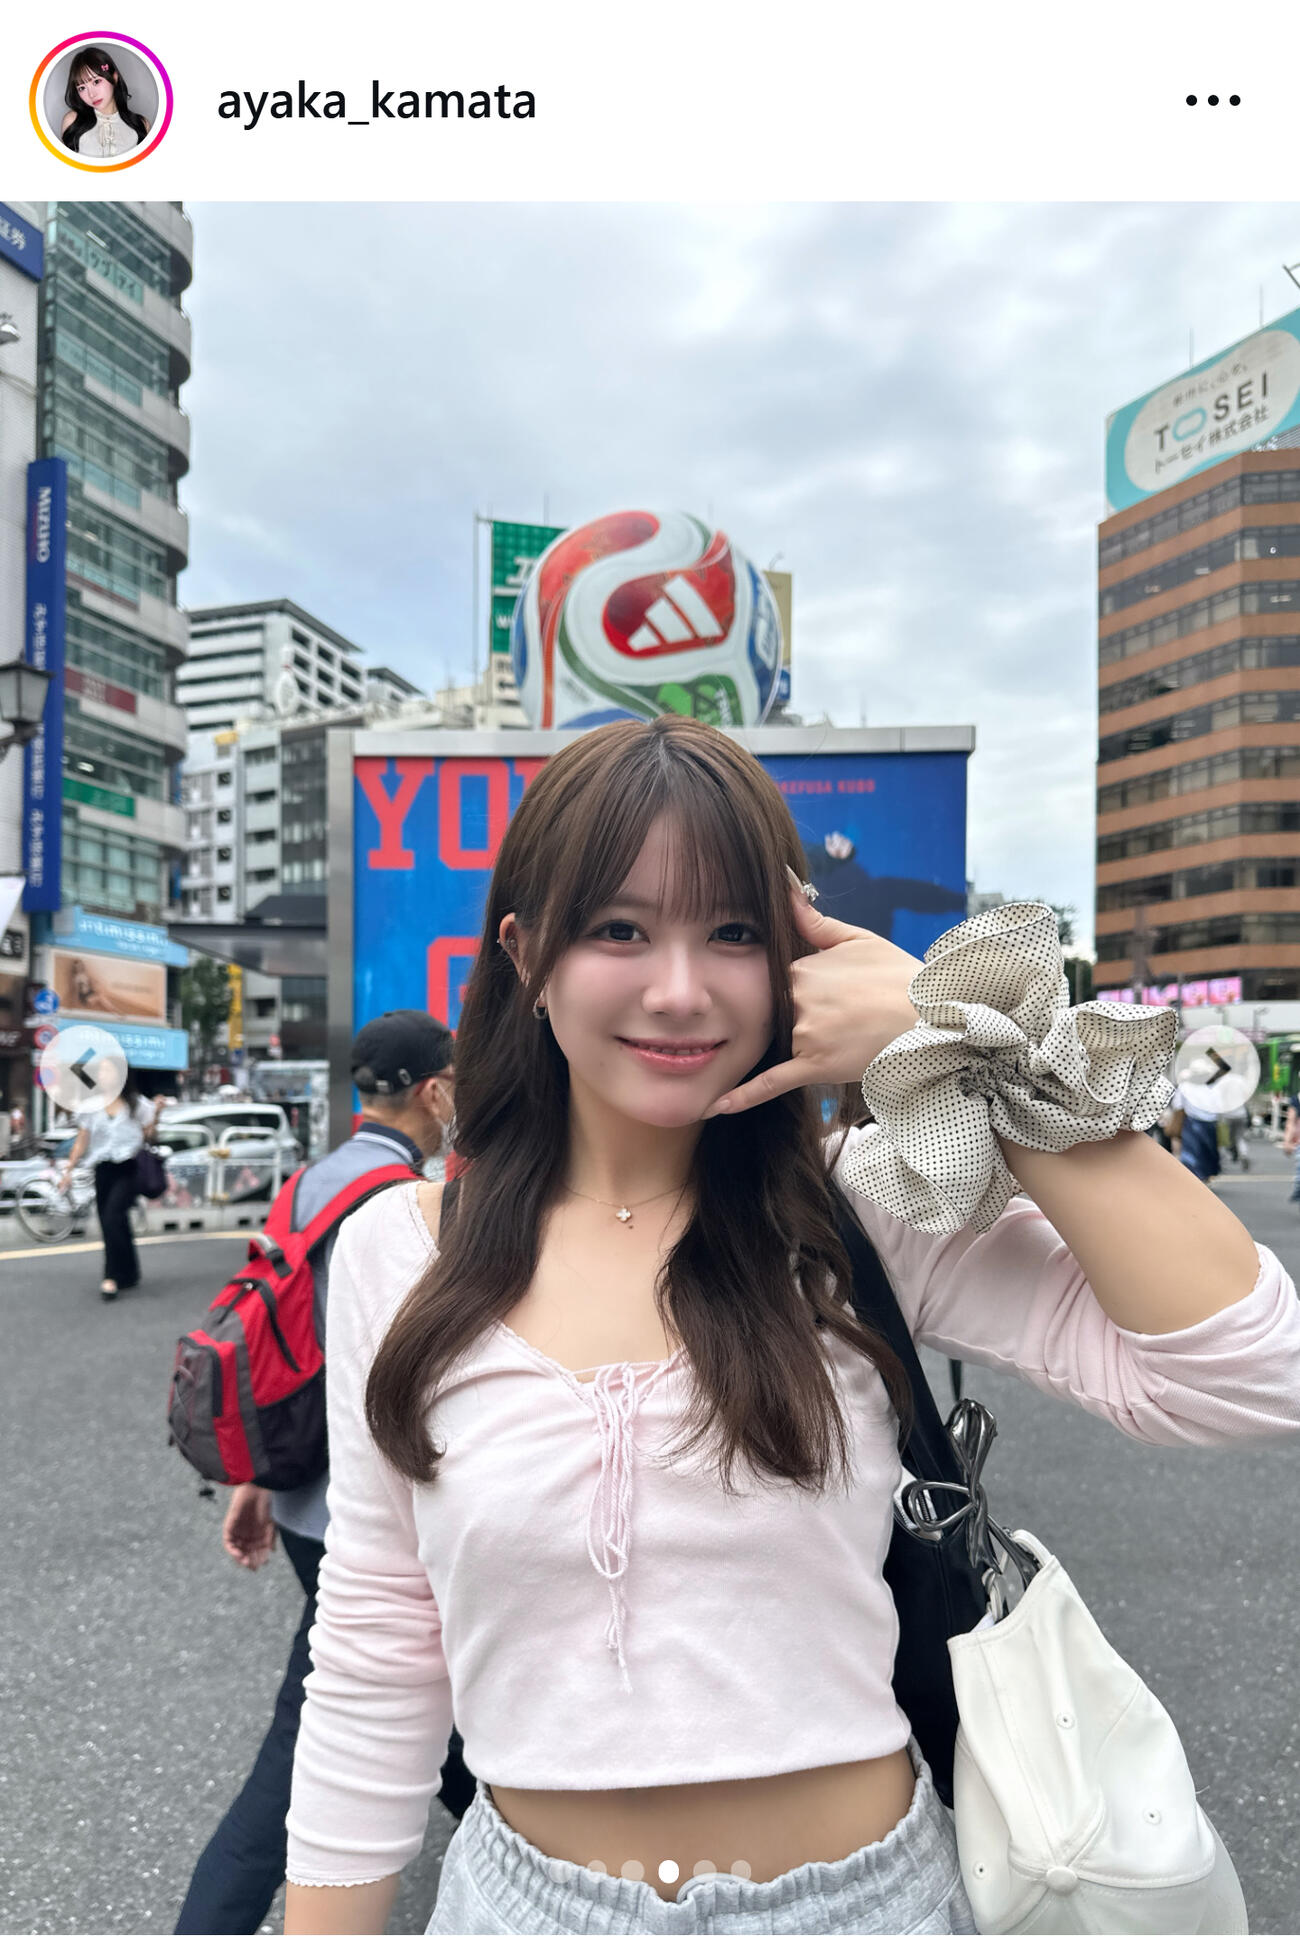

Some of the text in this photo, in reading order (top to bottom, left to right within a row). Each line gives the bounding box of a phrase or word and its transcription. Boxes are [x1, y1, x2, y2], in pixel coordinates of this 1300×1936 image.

[1154, 370, 1267, 451] TOSEI
[1155, 404, 1268, 473] トーセイ株式会社
